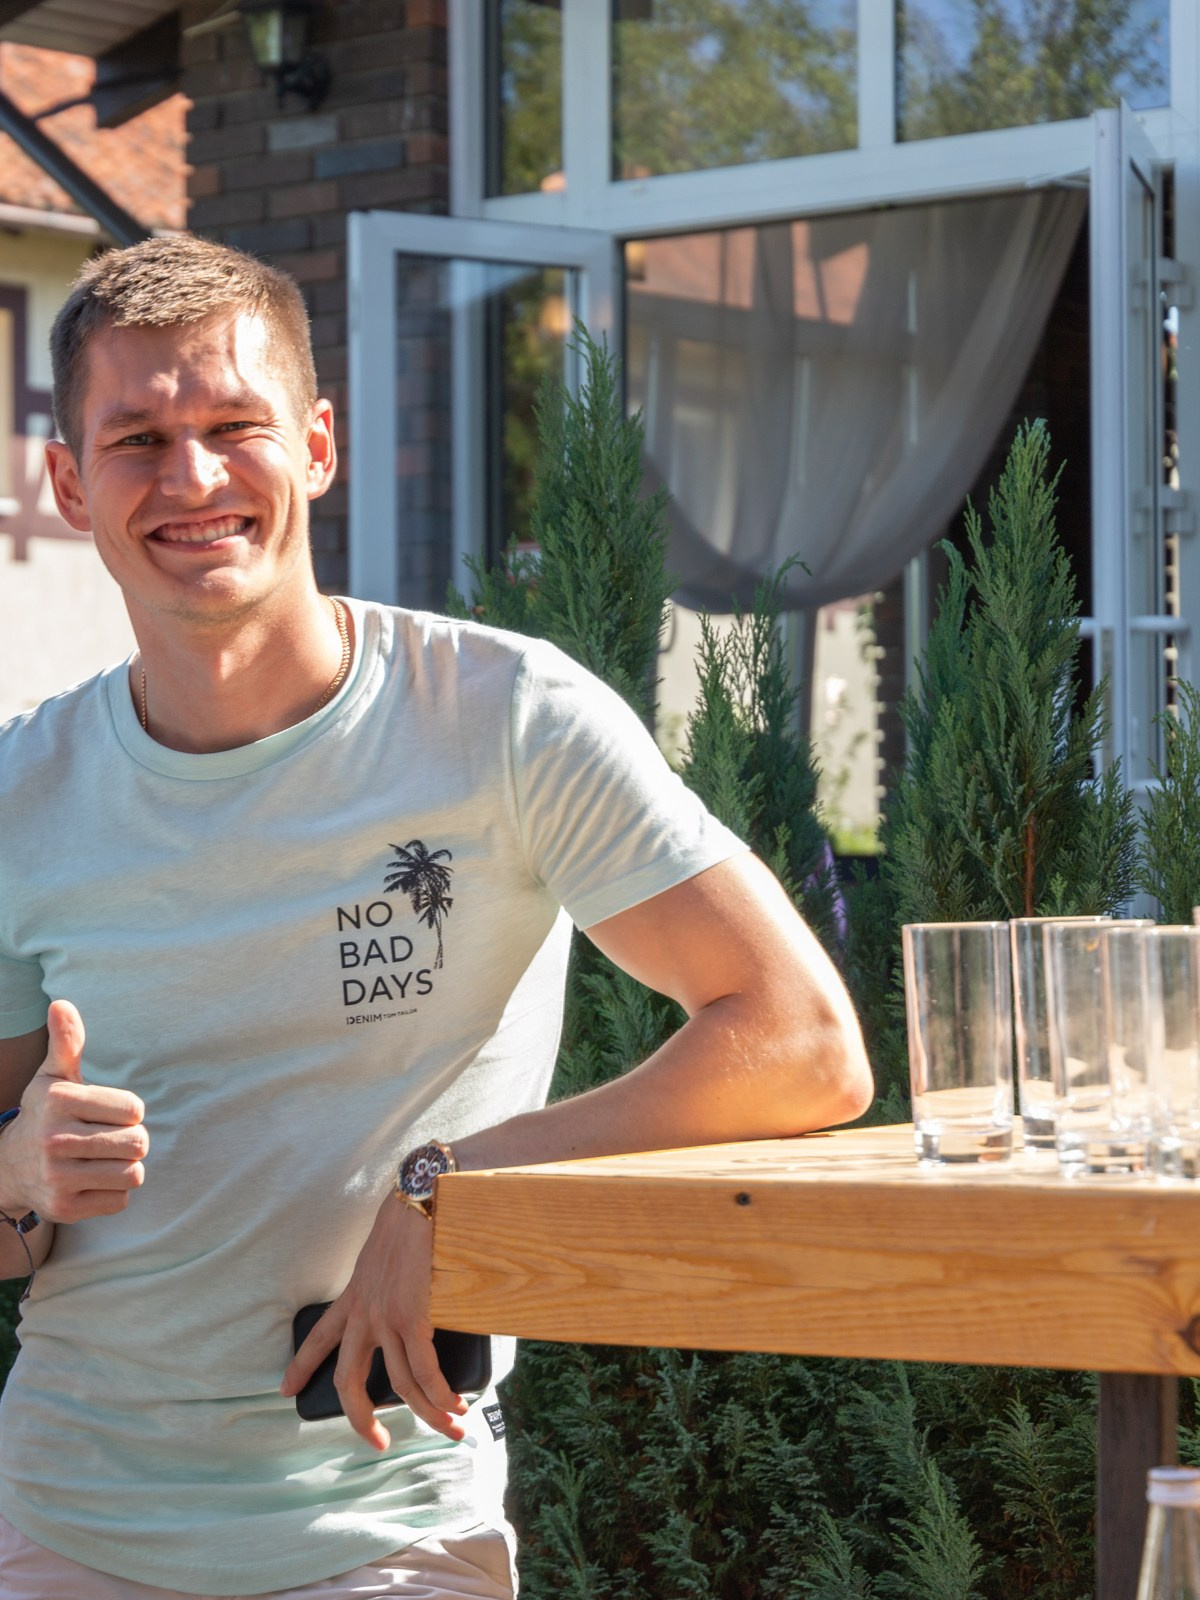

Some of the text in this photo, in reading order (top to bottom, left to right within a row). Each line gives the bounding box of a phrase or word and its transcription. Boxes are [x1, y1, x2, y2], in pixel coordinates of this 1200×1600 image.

[336, 901, 393, 932] NO
[339, 935, 414, 969] BAD
[342, 968, 434, 1006] DAYS
[346, 1013, 382, 1025] DENIM
